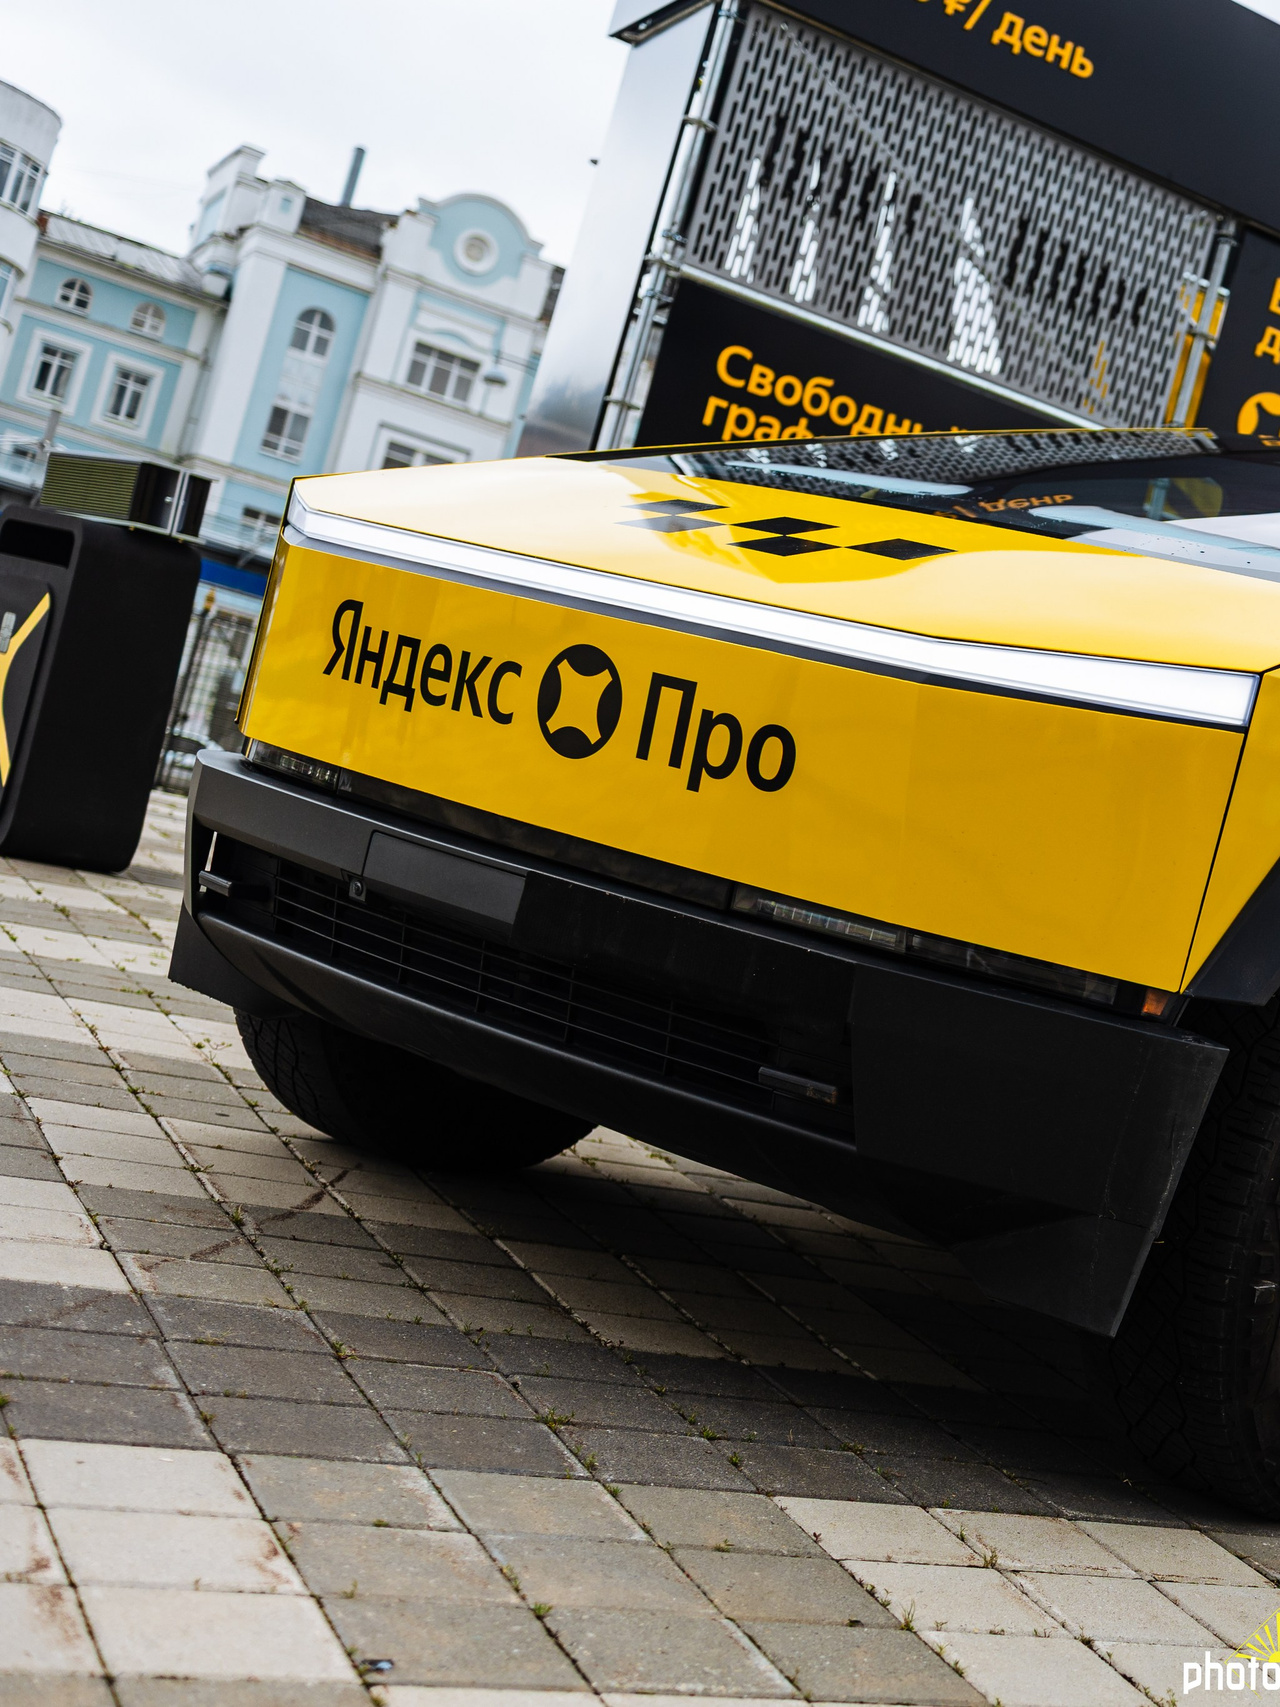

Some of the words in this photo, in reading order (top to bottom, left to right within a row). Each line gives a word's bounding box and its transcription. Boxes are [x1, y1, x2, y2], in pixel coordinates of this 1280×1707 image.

[991, 11, 1094, 78] день
[716, 345, 968, 436] Свободн
[322, 599, 523, 725] Яндекс
[635, 672, 797, 793] Про
